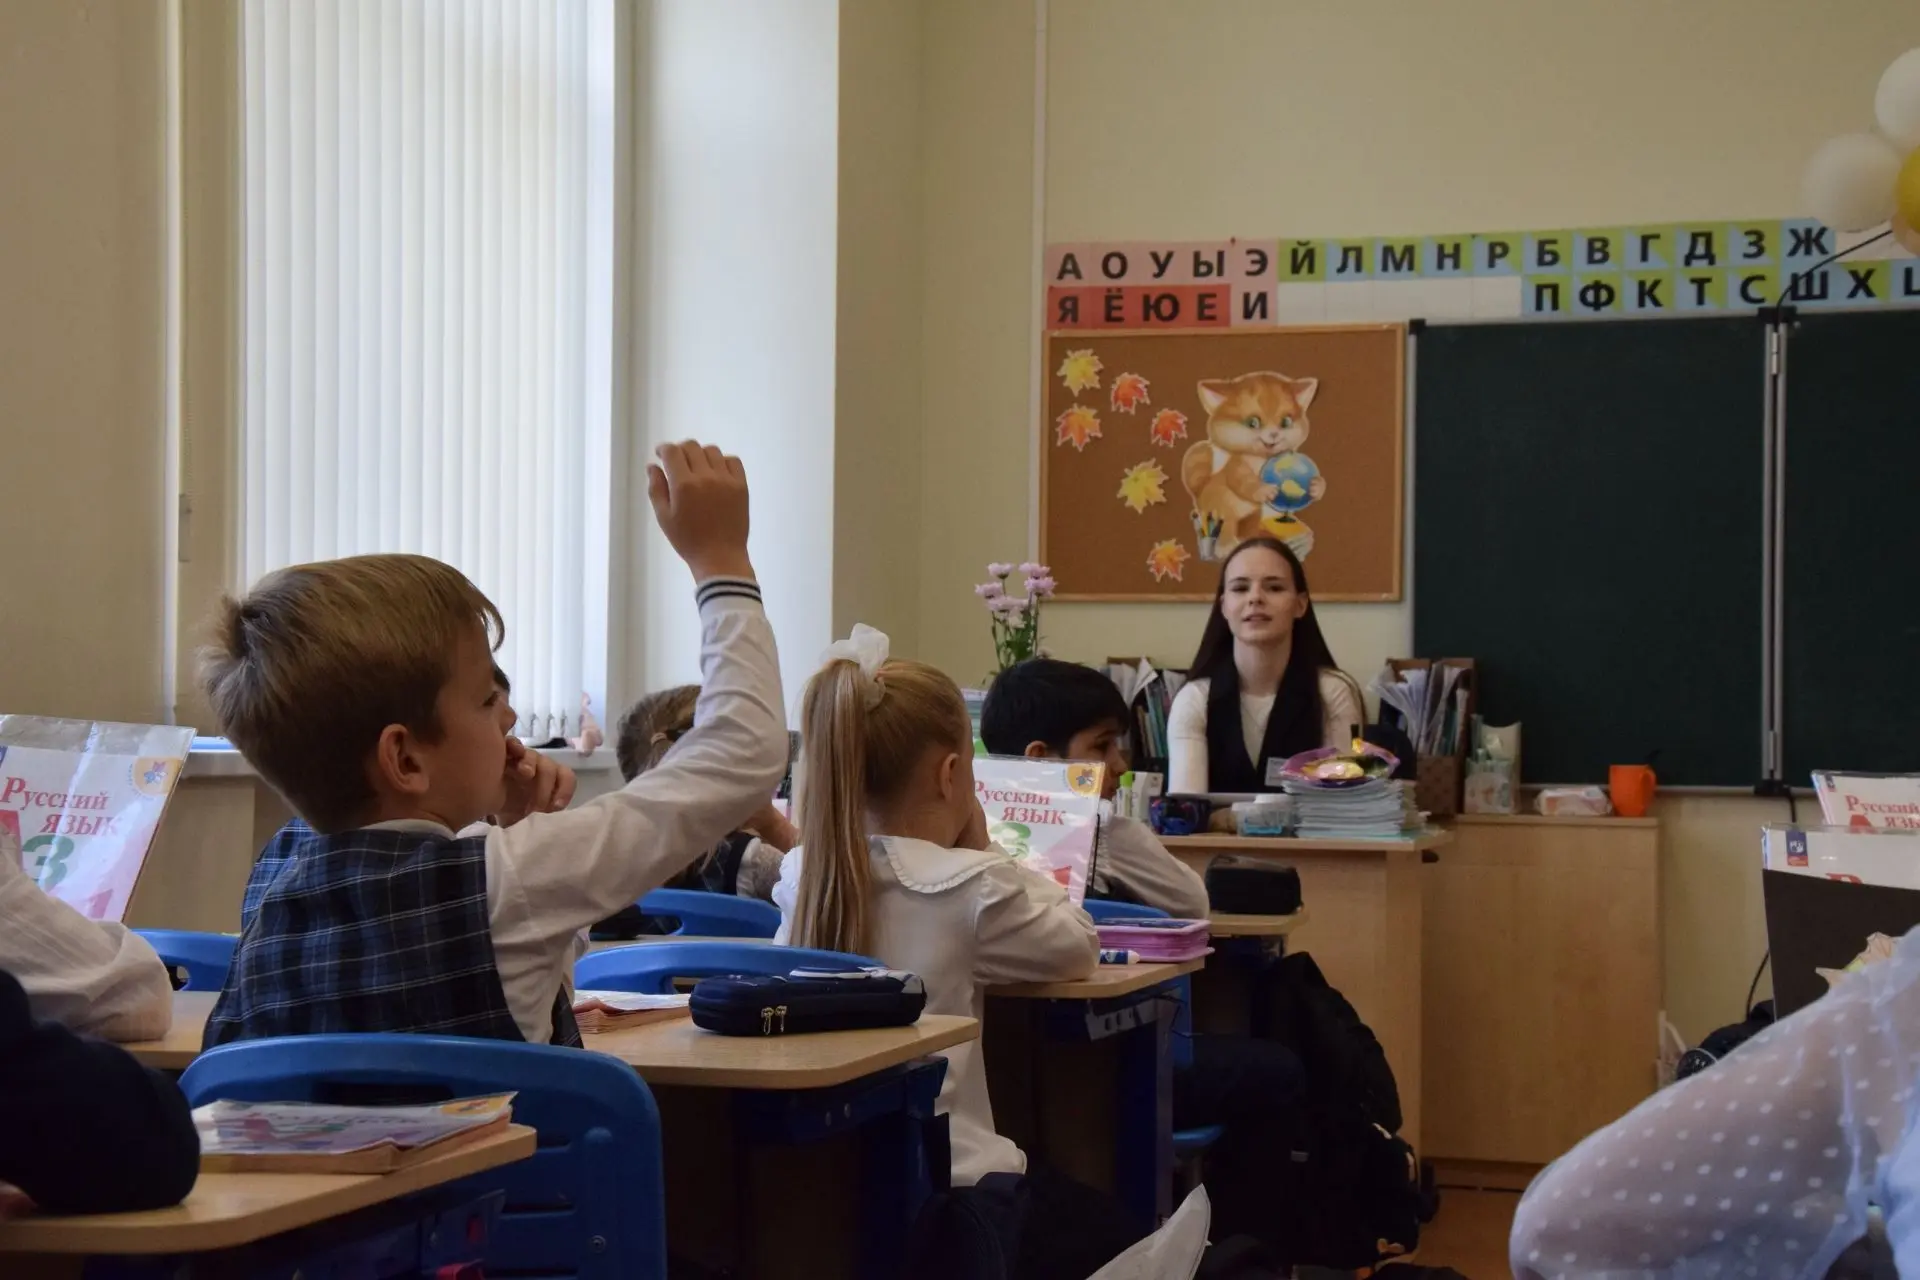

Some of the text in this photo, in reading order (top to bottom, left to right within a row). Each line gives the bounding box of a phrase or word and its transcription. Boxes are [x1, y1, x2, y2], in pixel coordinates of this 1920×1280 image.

[1057, 226, 1829, 280] А О У Ы Э Й Л М Н Р Б В Г Д З Ж
[1058, 295, 1079, 323] Я
[1105, 288, 1125, 323] Ё
[1142, 293, 1180, 322] Ю
[1196, 293, 1217, 320] Е
[1243, 292, 1268, 320] И
[1535, 283, 1560, 312] П
[1579, 279, 1616, 312] Ф
[1637, 279, 1664, 308] К
[1689, 277, 1713, 306] Т
[1739, 274, 1767, 305] С
[1790, 270, 1829, 301] Ш
[1846, 267, 1877, 299] Х
[1, 777, 109, 810] Русский
